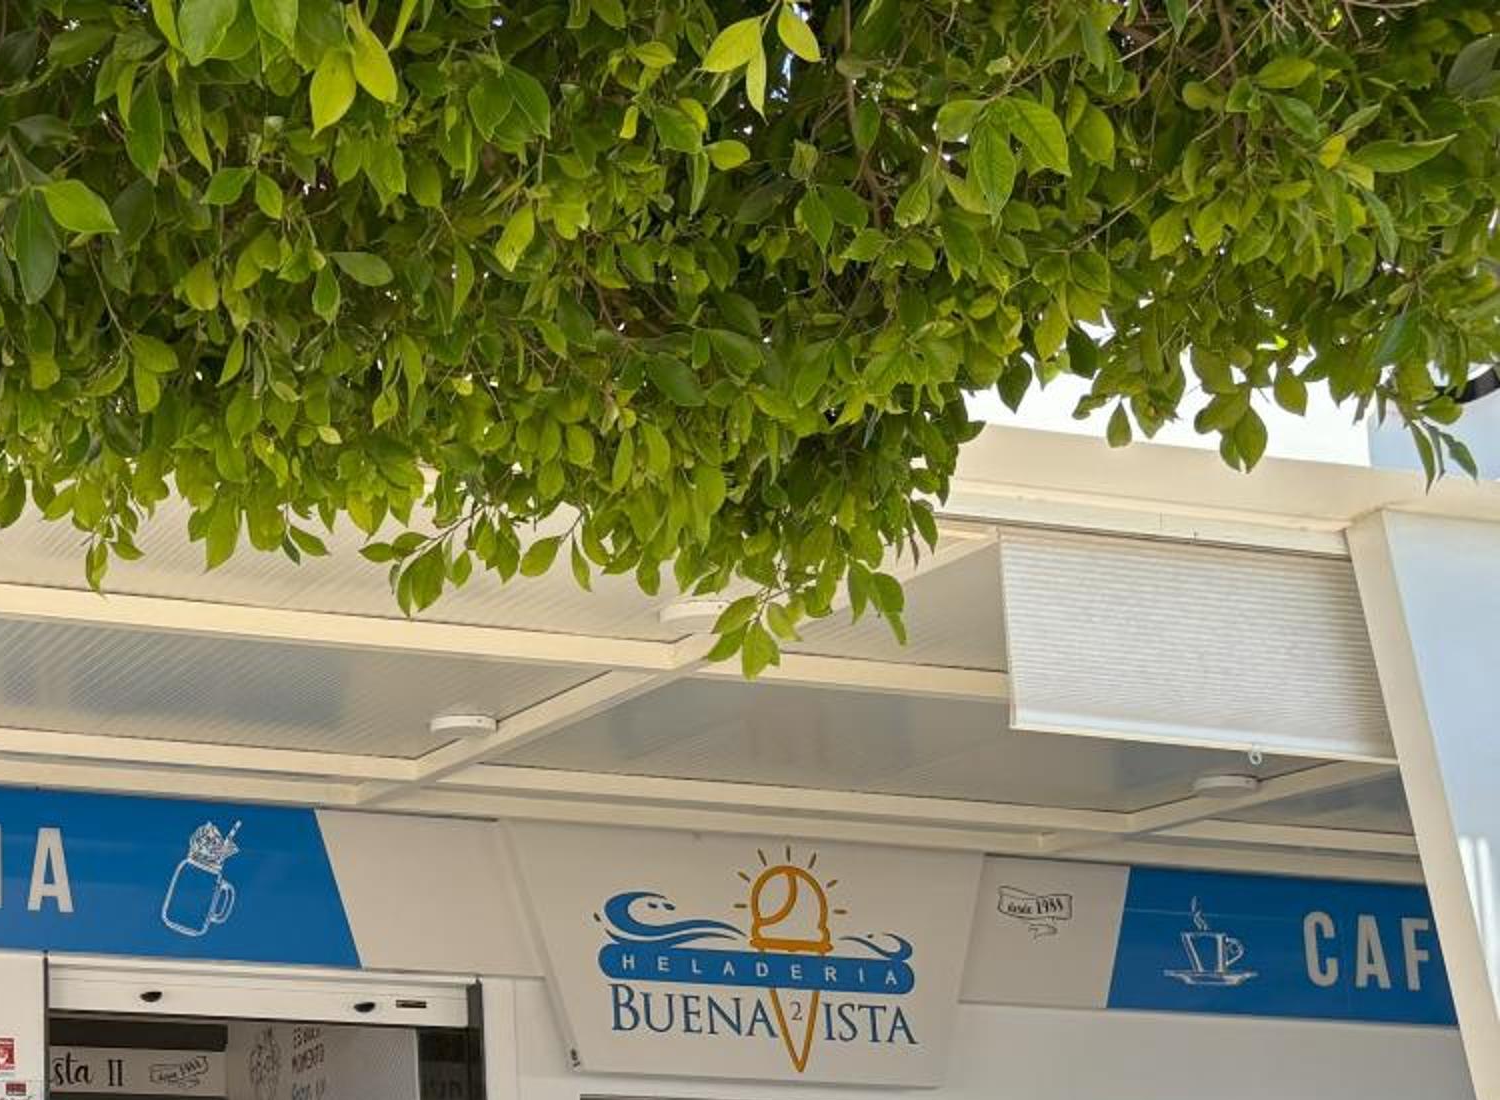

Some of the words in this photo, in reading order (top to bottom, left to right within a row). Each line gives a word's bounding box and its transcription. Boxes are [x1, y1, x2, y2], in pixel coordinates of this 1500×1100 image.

[620, 954, 899, 986] HELADERIA
[609, 983, 779, 1038] BUENA
[791, 1001, 804, 1022] 2
[50, 1052, 94, 1086] sta
